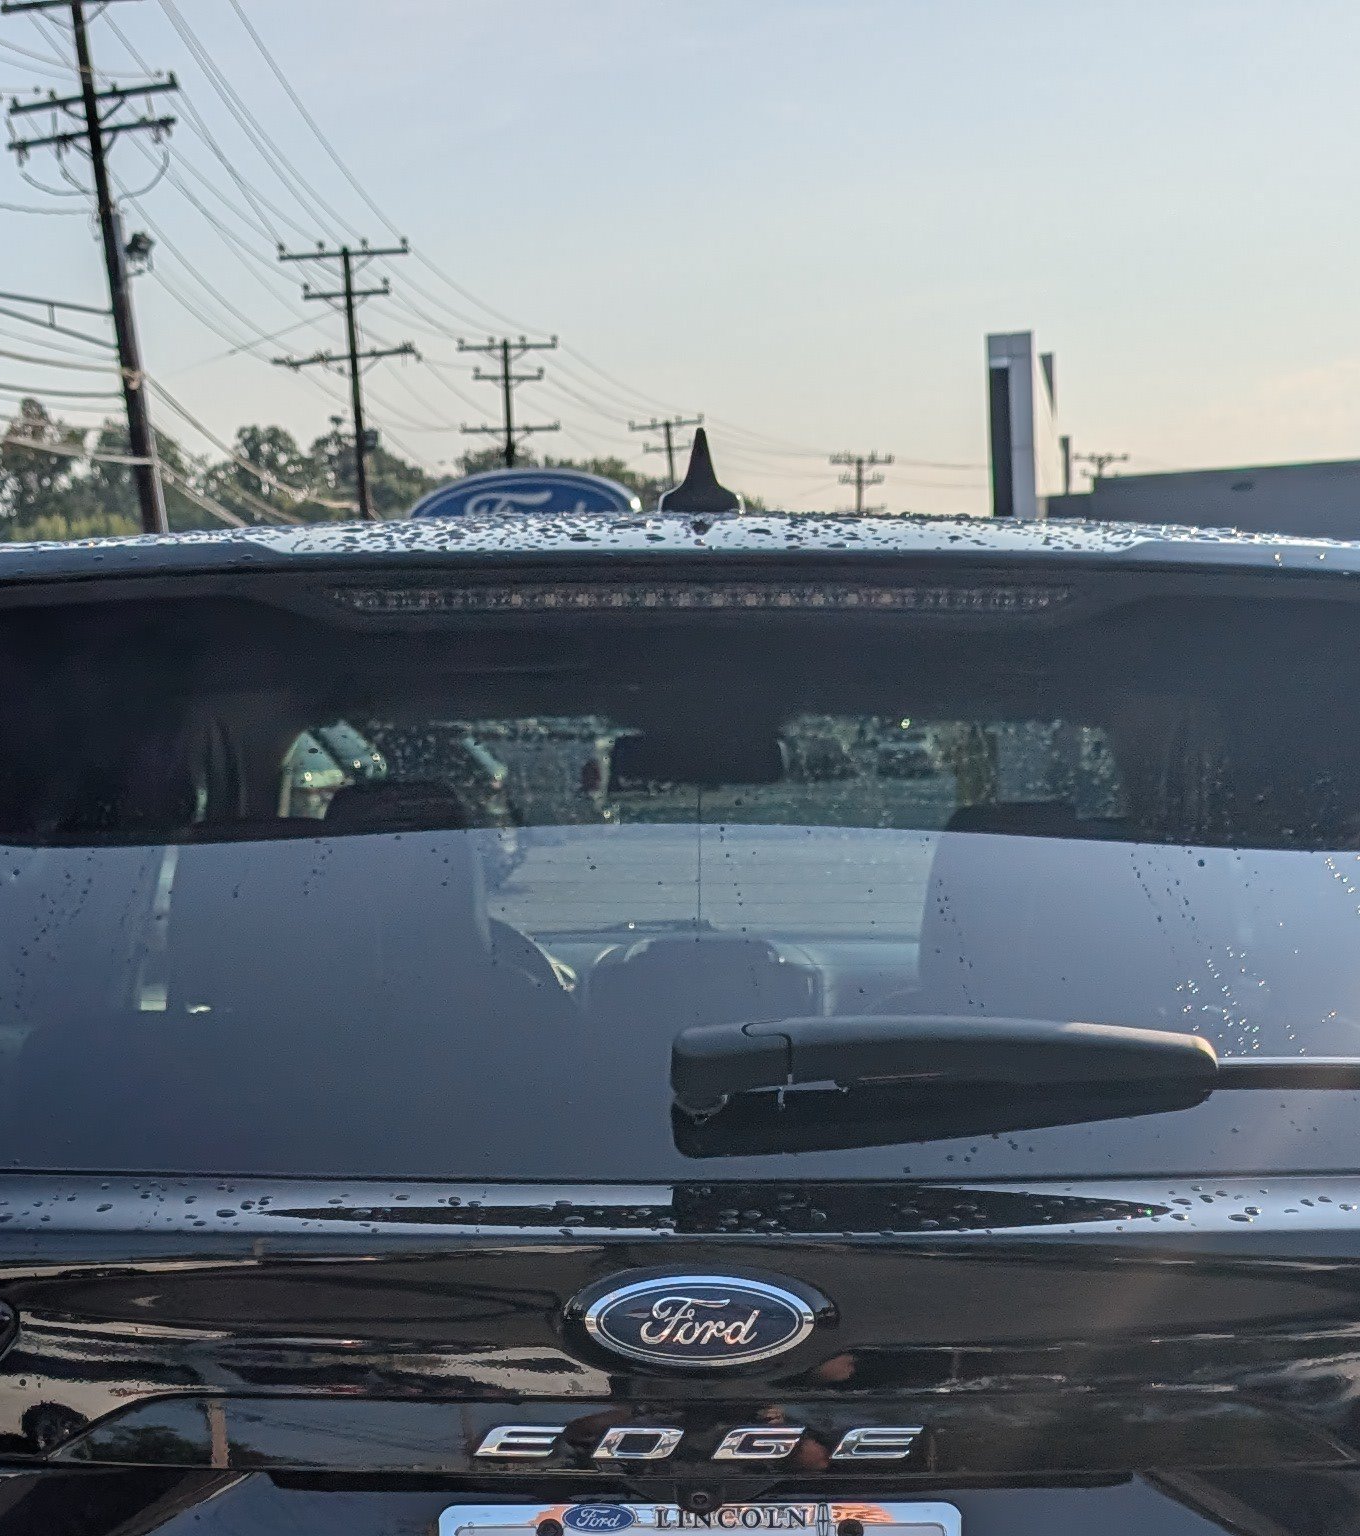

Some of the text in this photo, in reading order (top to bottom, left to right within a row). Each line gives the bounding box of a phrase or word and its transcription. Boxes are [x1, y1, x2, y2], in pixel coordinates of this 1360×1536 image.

[640, 1296, 761, 1345] Ford
[474, 1425, 924, 1460] EDGE
[575, 1508, 808, 1529] Ford LINCOLN
